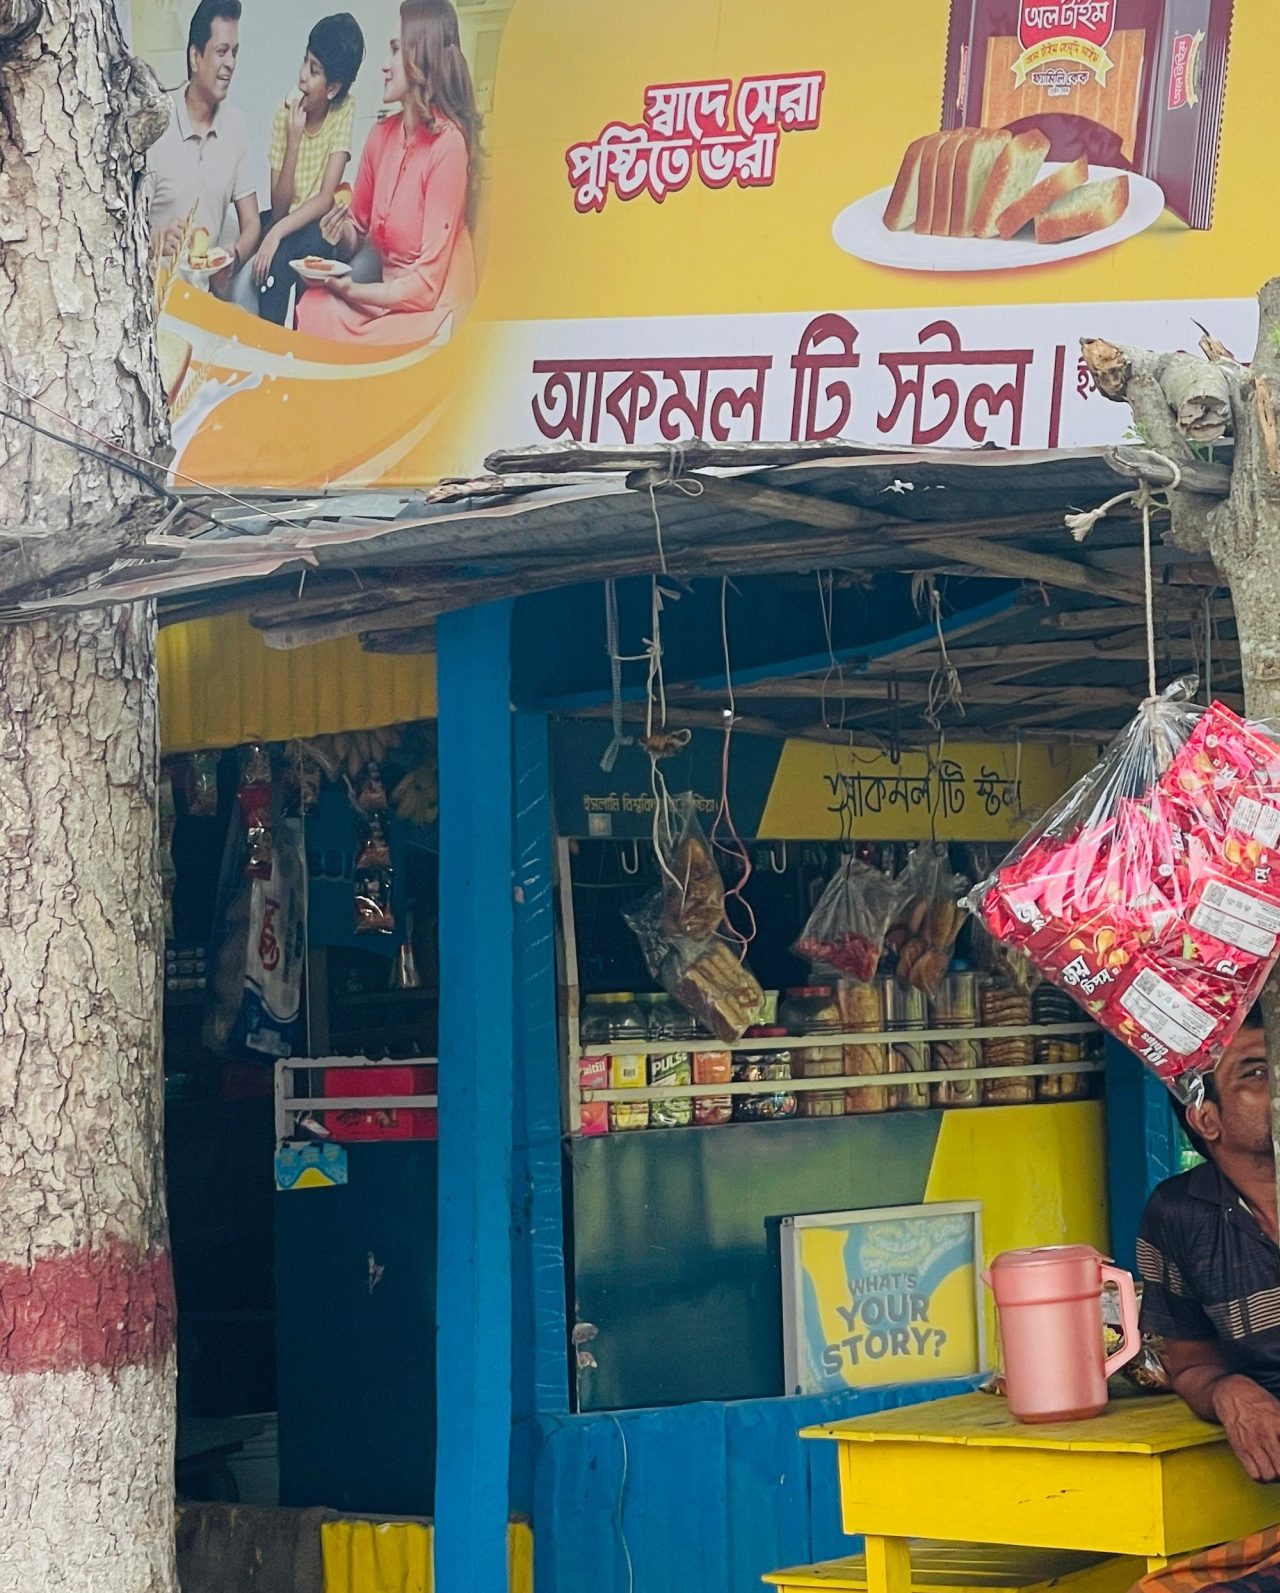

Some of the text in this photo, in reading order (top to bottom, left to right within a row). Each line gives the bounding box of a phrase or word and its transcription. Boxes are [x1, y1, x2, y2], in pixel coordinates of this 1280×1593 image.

[1024, 6, 1059, 29] অল
[648, 75, 822, 140] স্বাদে সেরা
[569, 125, 777, 205] পুষ্টিতে ভরা
[532, 354, 773, 446] আকমল
[791, 313, 860, 444] টি
[850, 1271, 918, 1297] WHAT'S
[835, 1293, 931, 1333] YOUR
[821, 1328, 948, 1377] STORY?
